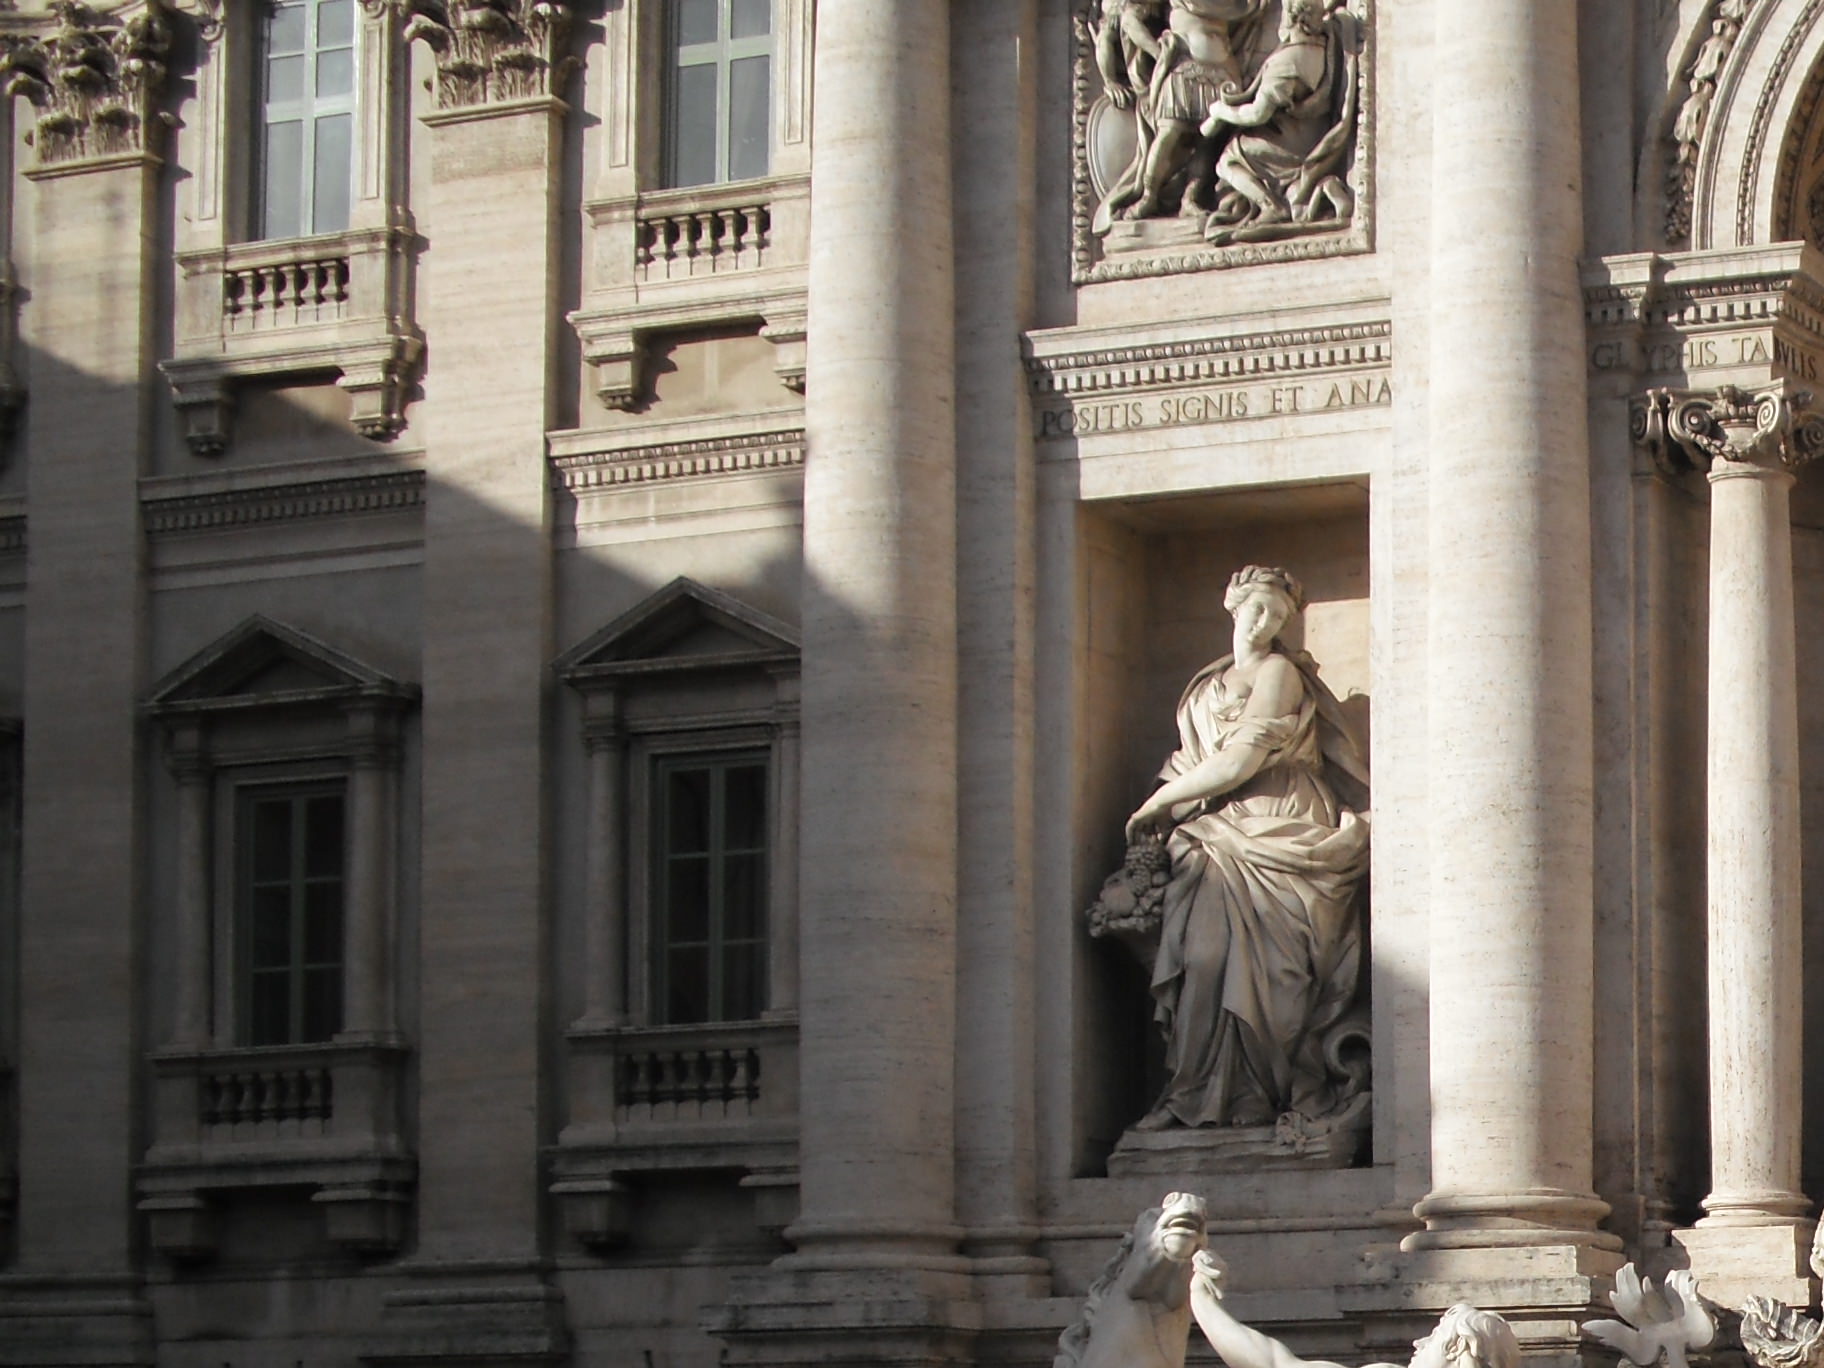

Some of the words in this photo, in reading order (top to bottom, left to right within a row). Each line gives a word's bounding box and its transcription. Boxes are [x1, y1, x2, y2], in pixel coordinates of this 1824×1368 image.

[1731, 335, 1817, 381] TABVLIS
[1038, 401, 1144, 437] POSITIS
[1159, 391, 1248, 424] SIGNIS
[1270, 385, 1304, 414] ET
[1324, 376, 1392, 408] ANA
